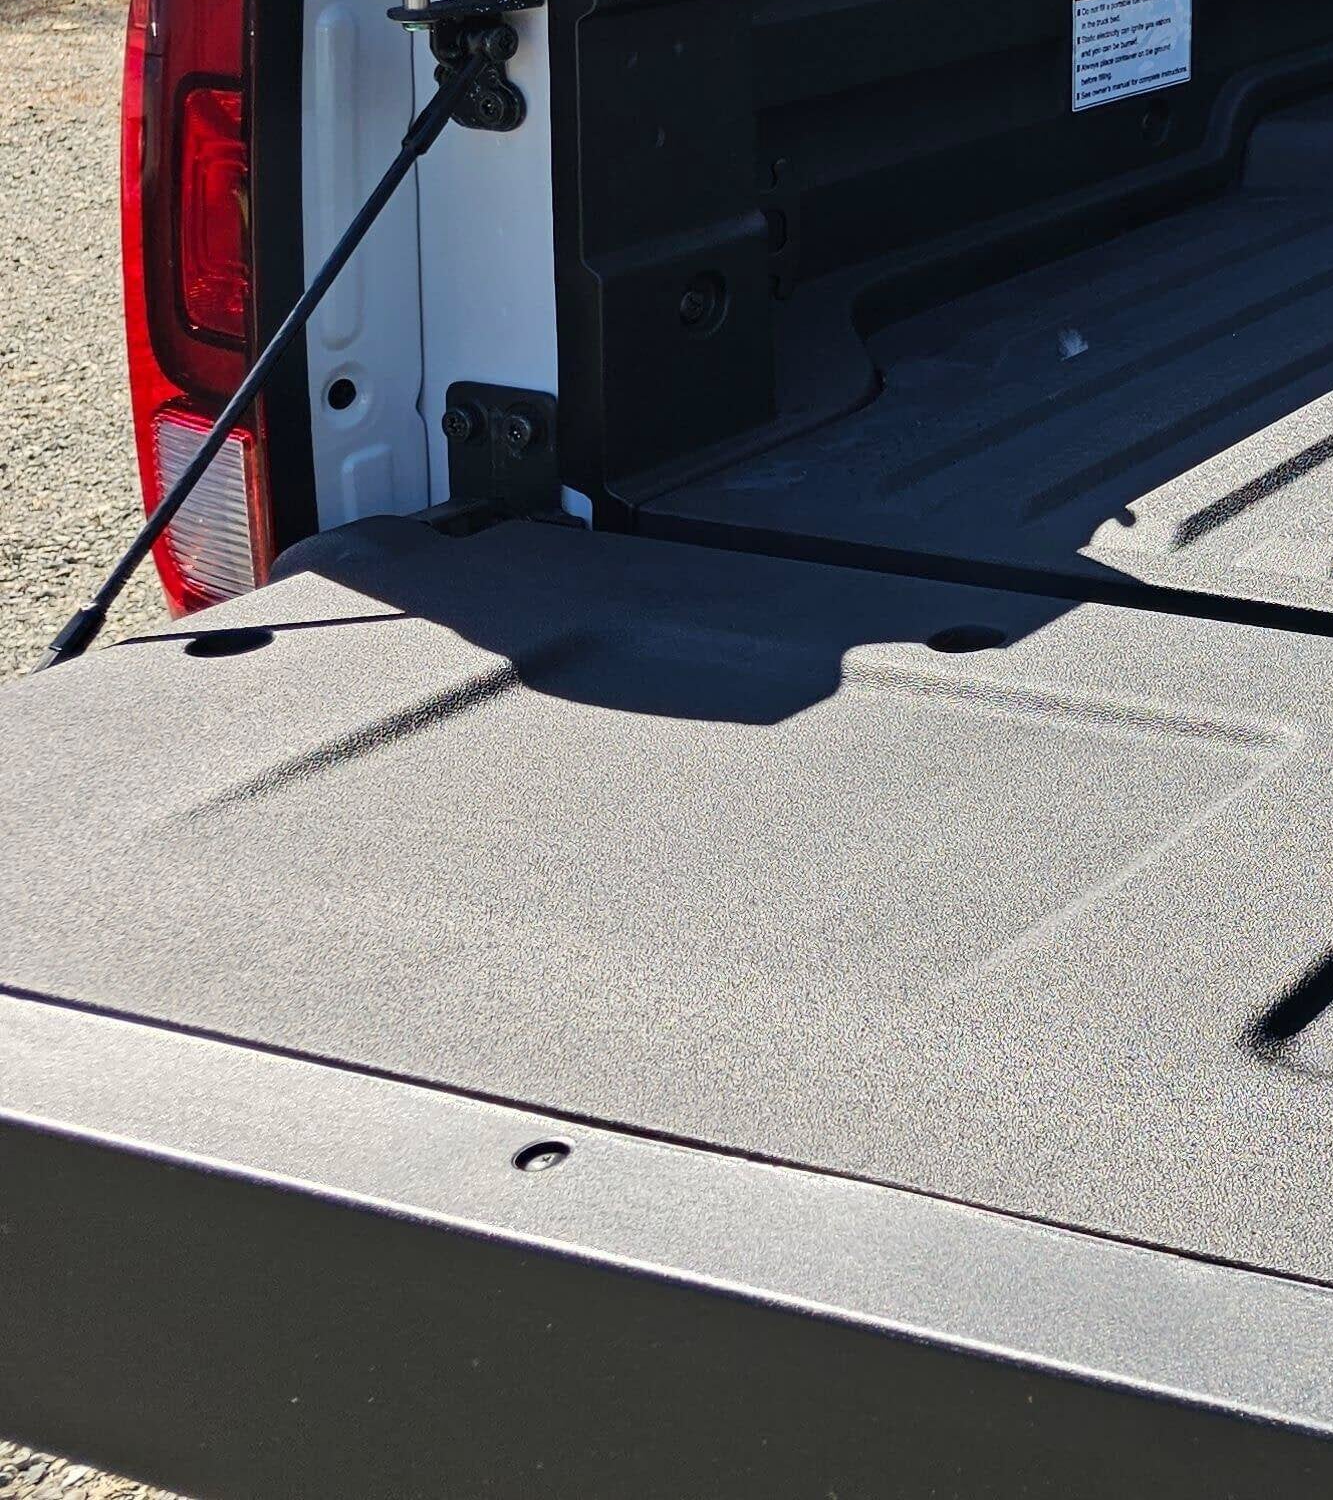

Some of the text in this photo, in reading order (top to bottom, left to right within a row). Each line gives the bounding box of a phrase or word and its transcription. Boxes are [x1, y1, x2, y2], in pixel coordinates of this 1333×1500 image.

[1096, 17, 1109, 26] truck
[1081, 49, 1091, 58] and
[1092, 47, 1101, 56] you
[1081, 61, 1099, 71] Always
[1100, 58, 1114, 68] place
[1115, 52, 1137, 63] container
[1081, 76, 1098, 86] before
[1081, 92, 1091, 100] See
[1112, 81, 1130, 91] manual
[1139, 72, 1160, 84] complete
